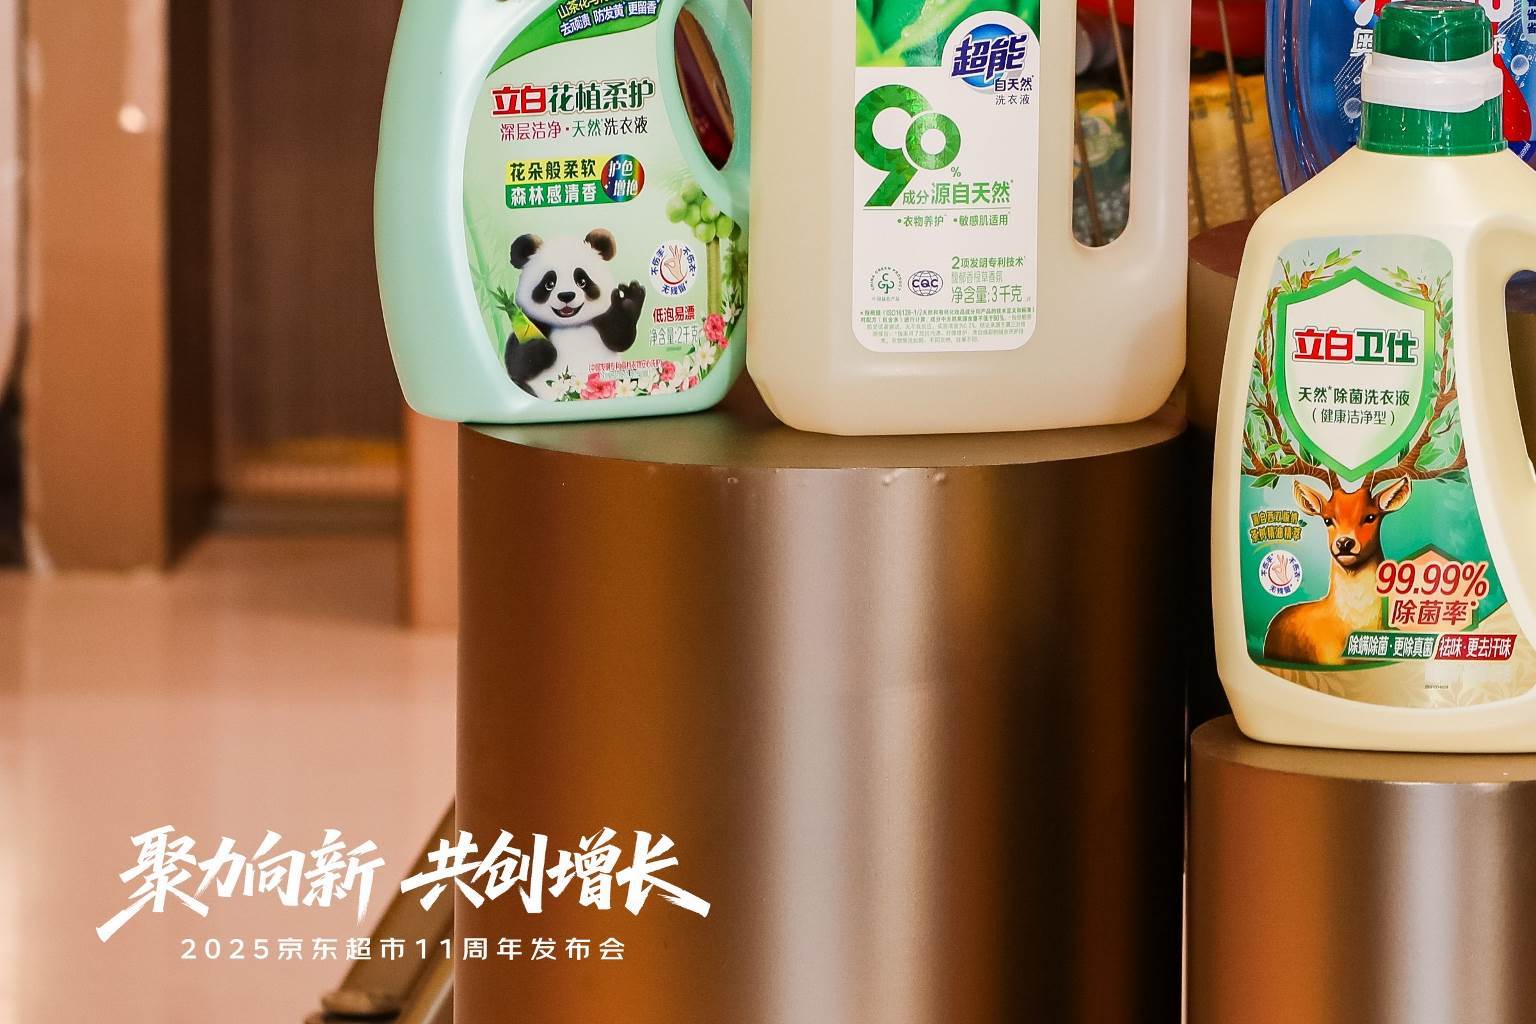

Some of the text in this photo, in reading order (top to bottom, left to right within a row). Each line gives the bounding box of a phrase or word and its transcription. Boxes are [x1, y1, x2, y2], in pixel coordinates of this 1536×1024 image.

[628, 0, 657, 15] 更留香
[951, 32, 1028, 81] 超能
[994, 76, 1032, 92] 自天然
[995, 94, 1031, 106] 洗衣液
[510, 159, 596, 181] 花朵般柔软
[511, 183, 597, 206] 森林感清香
[902, 214, 1009, 227] 衣物养护 敏感肌适用
[912, 279, 938, 288] CQC
[652, 305, 695, 323] 低泡易漂
[1293, 328, 1418, 364] 立白卫仕
[1376, 562, 1487, 597] 99.99%
[1391, 599, 1469, 626] 除菌率
